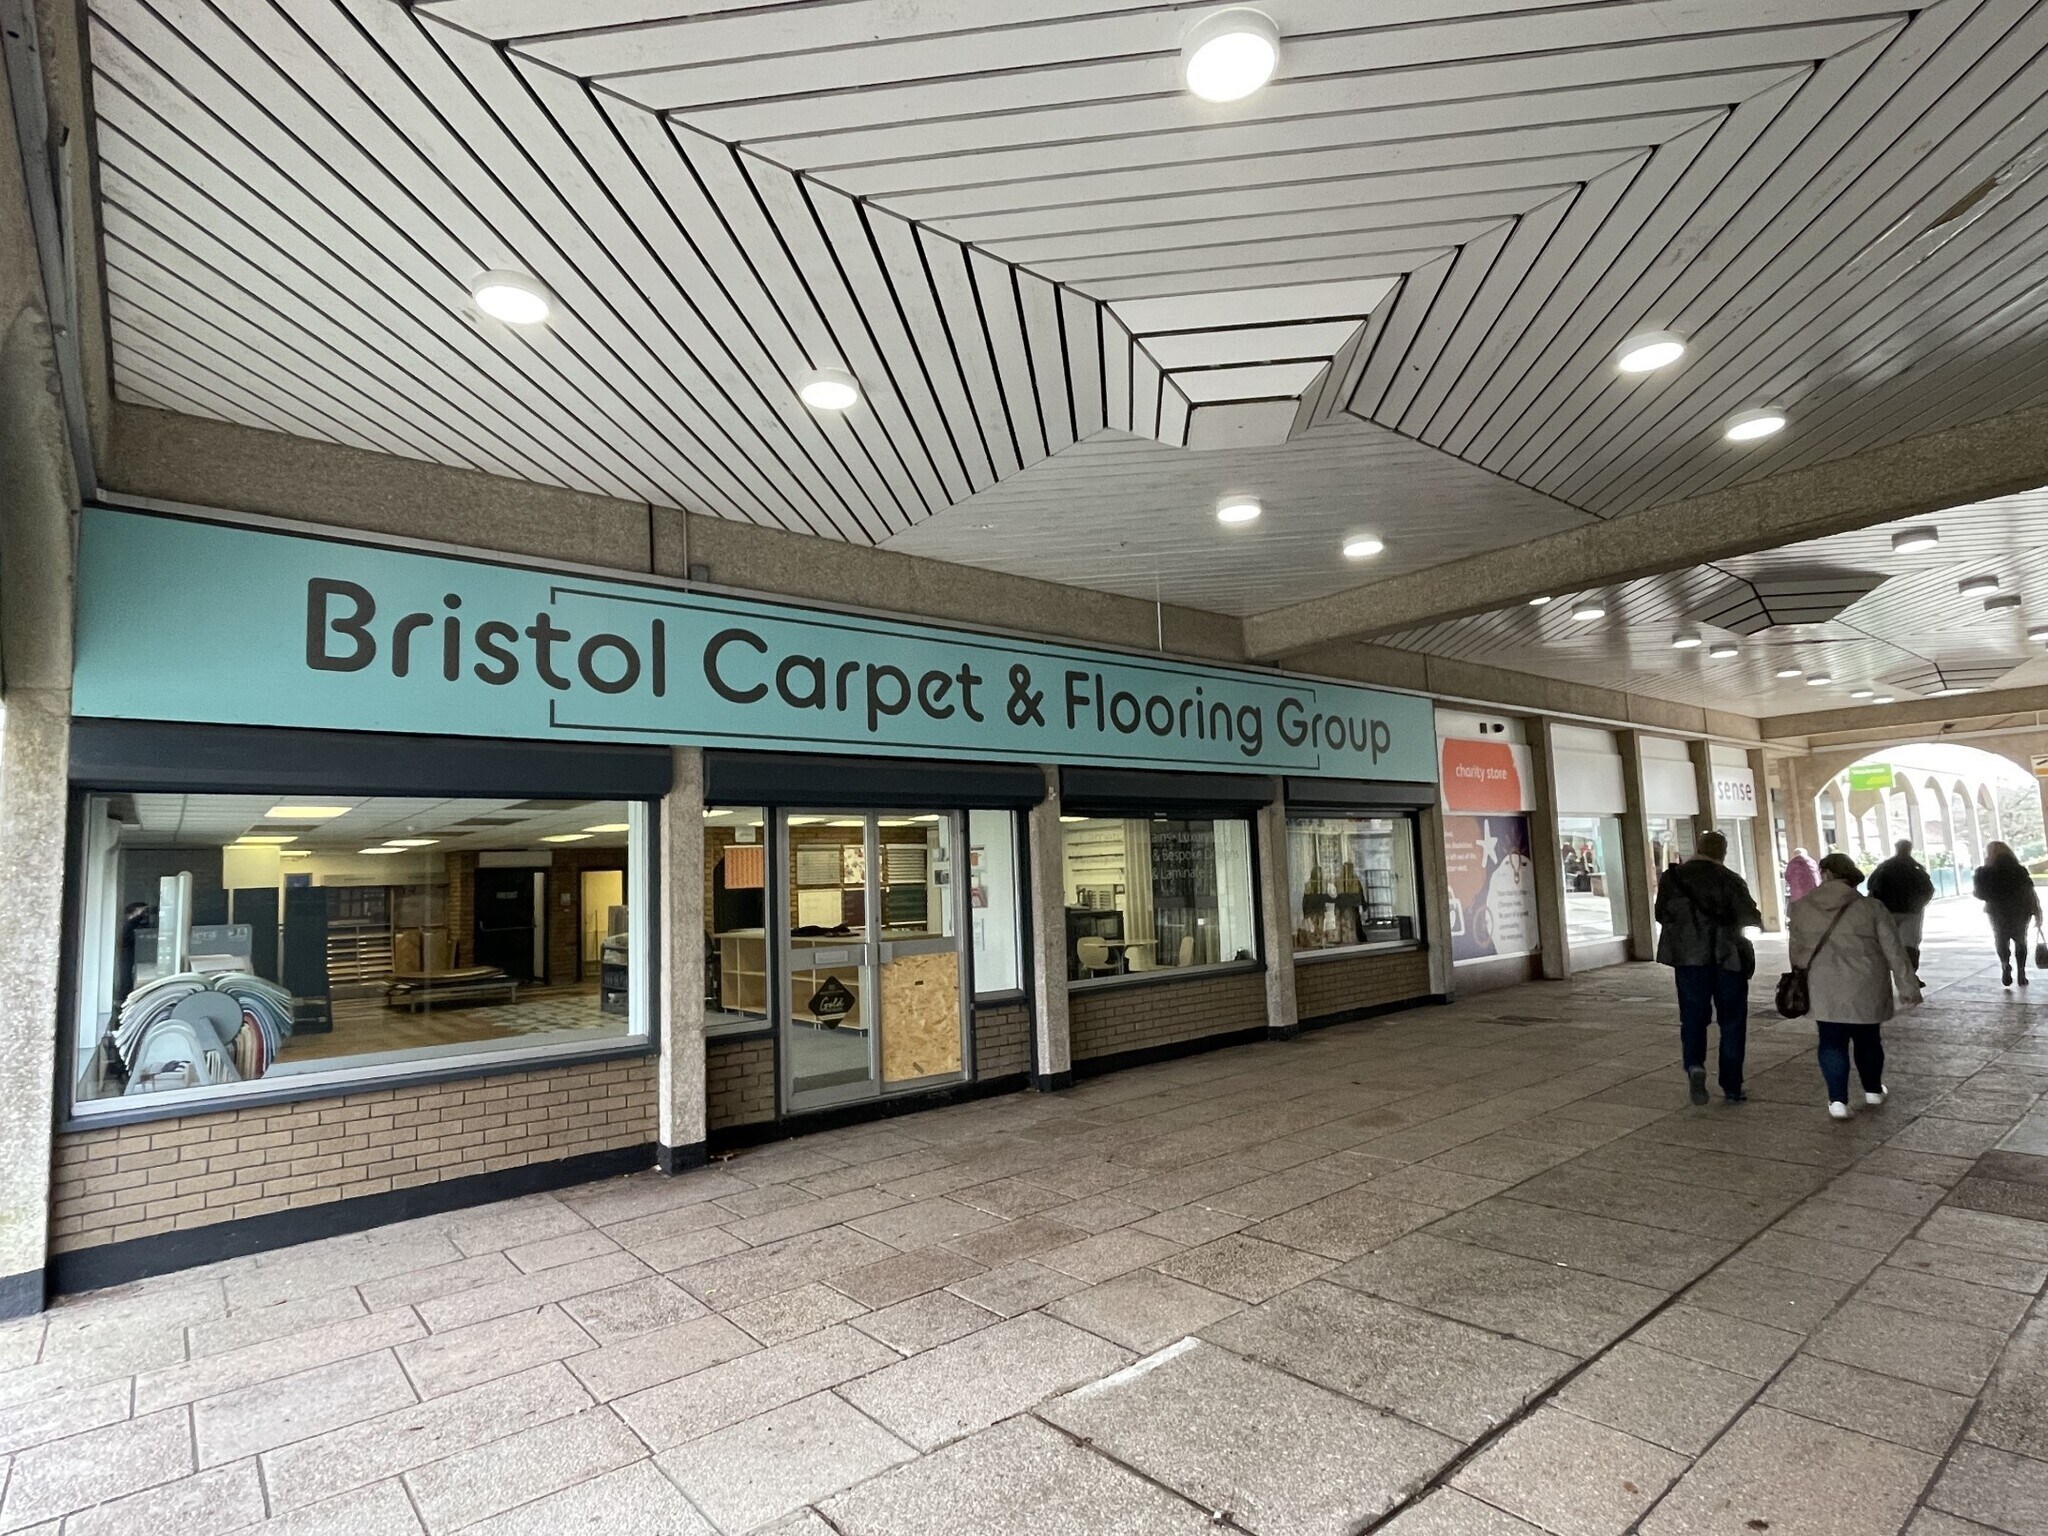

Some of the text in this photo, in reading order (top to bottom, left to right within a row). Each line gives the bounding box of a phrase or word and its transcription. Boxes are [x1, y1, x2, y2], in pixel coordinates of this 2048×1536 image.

[307, 577, 1392, 766] Bristol Carpet & Flooring Group
[1455, 762, 1508, 782] charity store
[1717, 781, 1752, 801] sense
[1178, 832, 1209, 846] Luxury
[1161, 848, 1203, 864] Bespoke
[1160, 864, 1205, 880] Laminate
